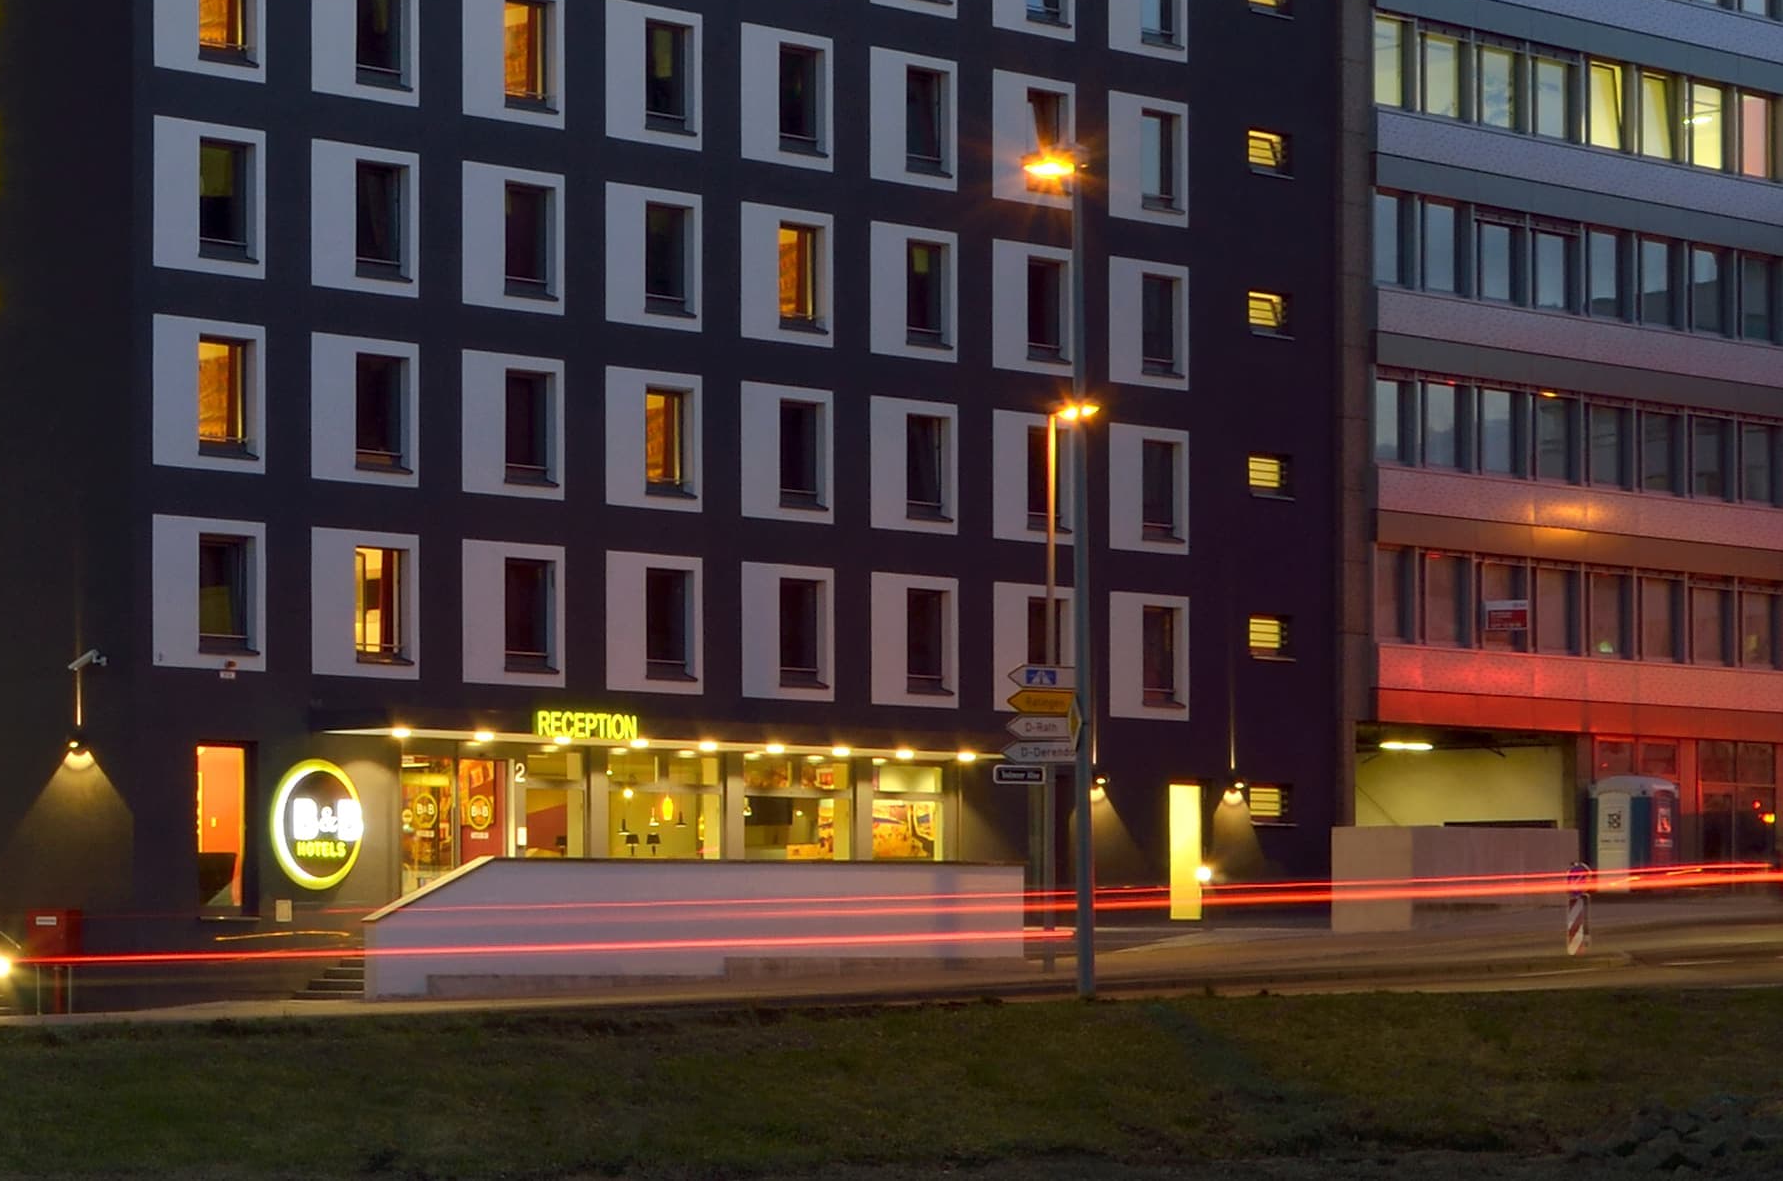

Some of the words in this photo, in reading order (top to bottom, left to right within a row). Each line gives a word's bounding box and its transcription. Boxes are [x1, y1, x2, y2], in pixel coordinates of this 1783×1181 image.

[537, 710, 638, 740] RECEPTION
[515, 762, 526, 783] 2
[293, 797, 365, 842] B&B
[296, 840, 347, 858] HOTELS
